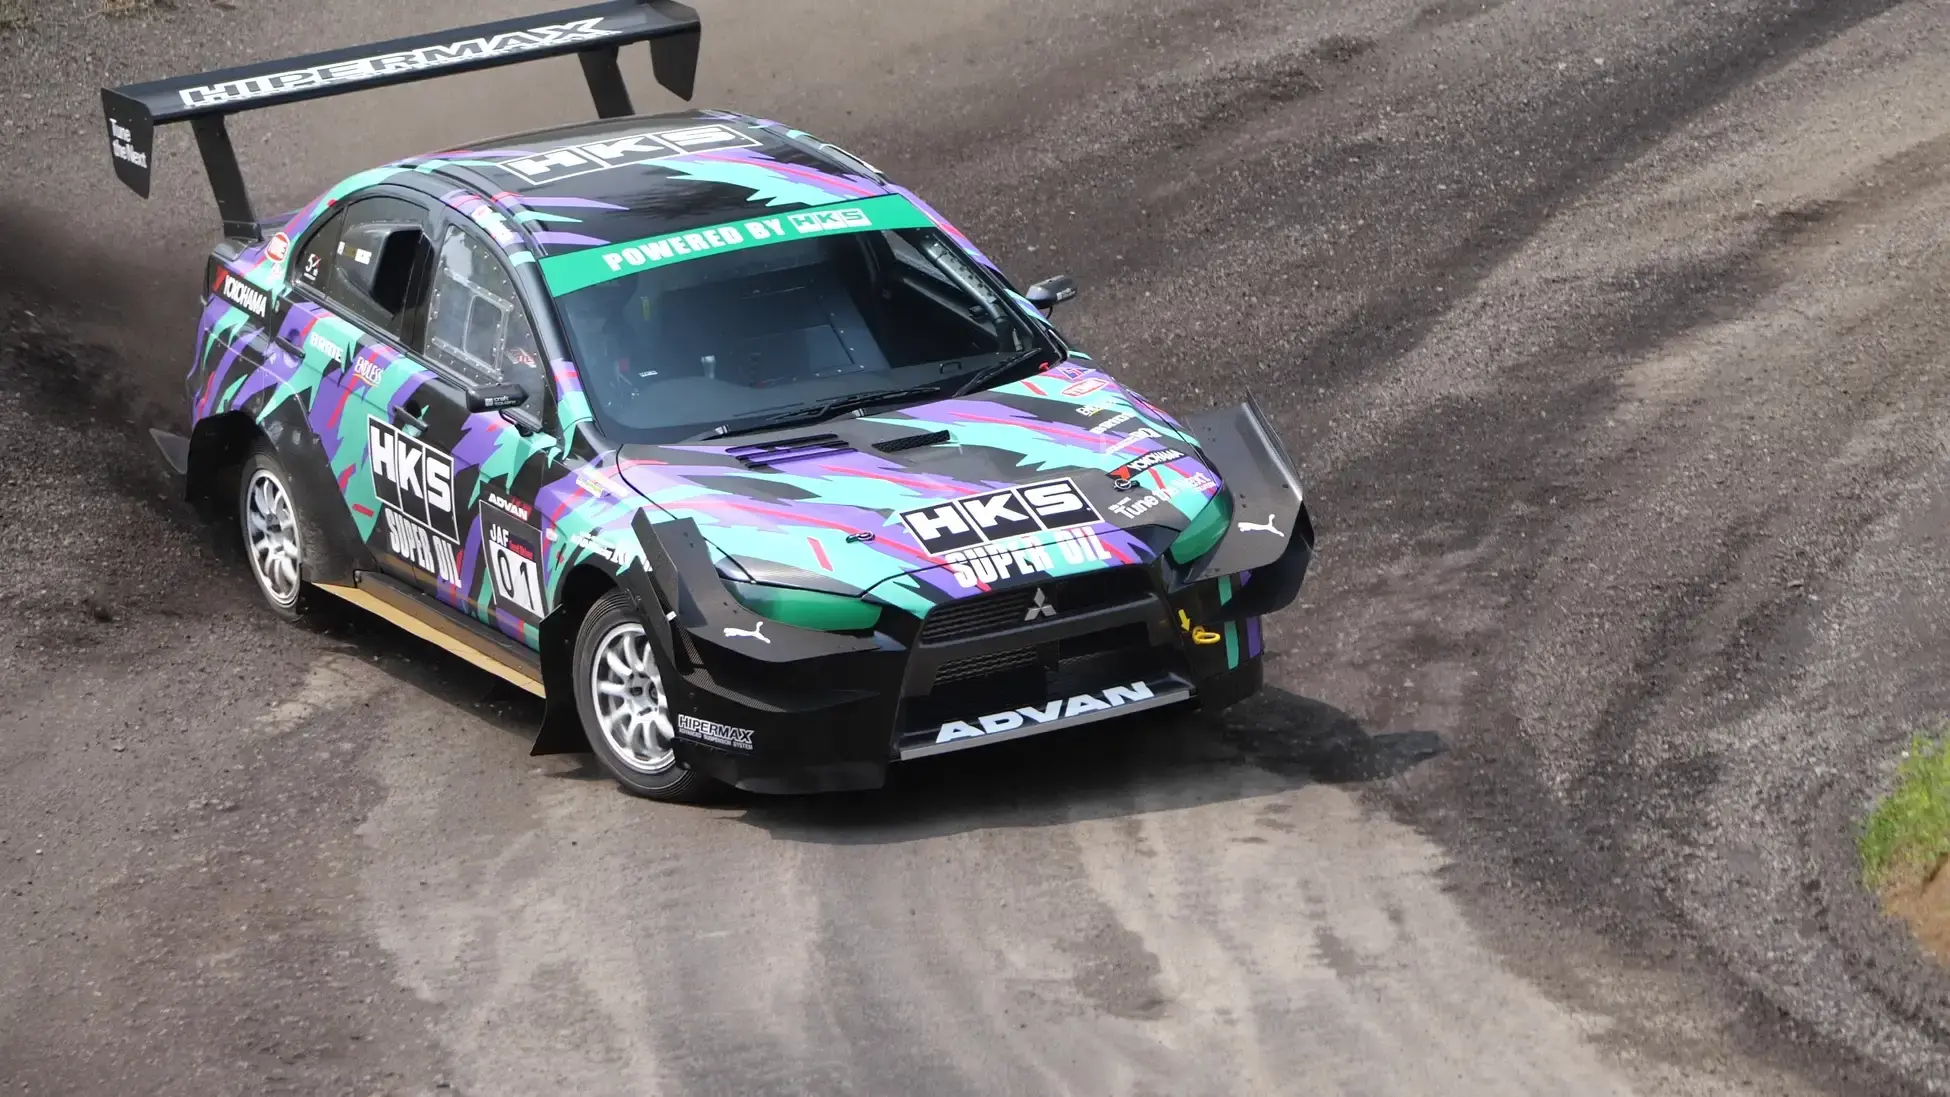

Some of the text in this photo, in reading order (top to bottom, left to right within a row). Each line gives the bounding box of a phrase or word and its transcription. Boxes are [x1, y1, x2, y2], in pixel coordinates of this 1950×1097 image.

[179, 17, 622, 106] HIPERMAX
[109, 118, 131, 142] Tune
[509, 126, 735, 176] HKS
[113, 139, 147, 168] the Next
[602, 208, 872, 271] POWERED BY HKS
[223, 275, 268, 318] YOKOHAMA
[354, 357, 384, 384] ENDLESS
[371, 426, 451, 512] HKS
[1127, 449, 1184, 471] YOKOHAMA
[488, 493, 528, 521] ADVAN
[905, 483, 1084, 541] HKS
[1114, 495, 1159, 519] Tune
[385, 508, 462, 588] SUPER OIL
[490, 524, 509, 547] JAF
[945, 526, 1112, 588] SUPER OIL
[498, 549, 536, 611] 01
[678, 714, 755, 744] HIPERMAX
[935, 681, 1155, 743] ADVAN
